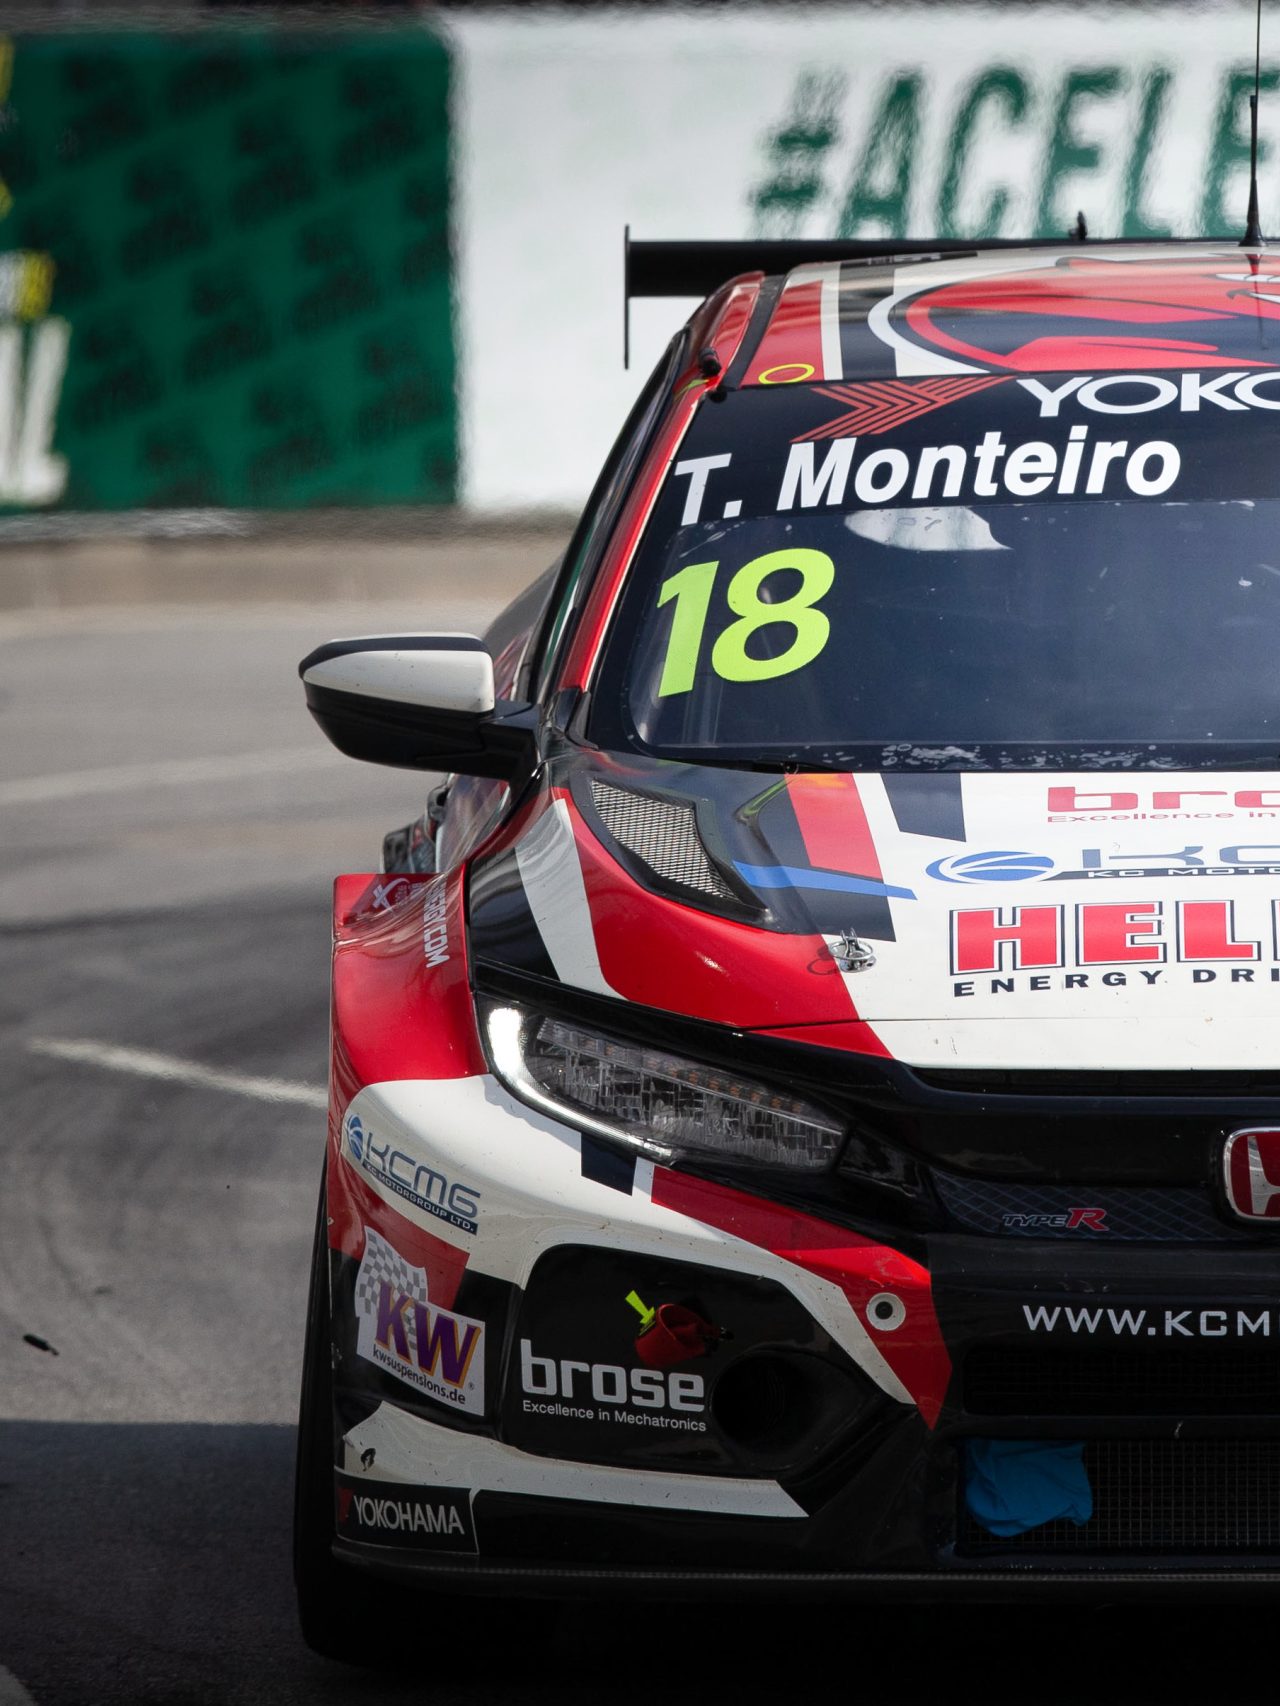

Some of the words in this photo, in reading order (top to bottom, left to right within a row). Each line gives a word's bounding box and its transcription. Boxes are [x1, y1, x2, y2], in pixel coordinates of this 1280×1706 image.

[674, 453, 742, 526] T.
[776, 425, 1182, 511] Monteiro
[656, 548, 836, 699] 18
[1047, 812, 1234, 823] Excellence
[954, 970, 1163, 998] ENERGY
[366, 1132, 481, 1218] KCMG
[378, 1172, 448, 1217] MOTORGROUP
[450, 1214, 474, 1232] LTD.
[375, 1280, 482, 1389] KW
[372, 1344, 466, 1405] kwsuspensions.de
[520, 1338, 705, 1412] brose
[522, 1399, 594, 1420] Excellence
[598, 1408, 610, 1421] in
[614, 1410, 707, 1432] Mechatronics
[353, 1495, 465, 1535] YOKOHAMA
